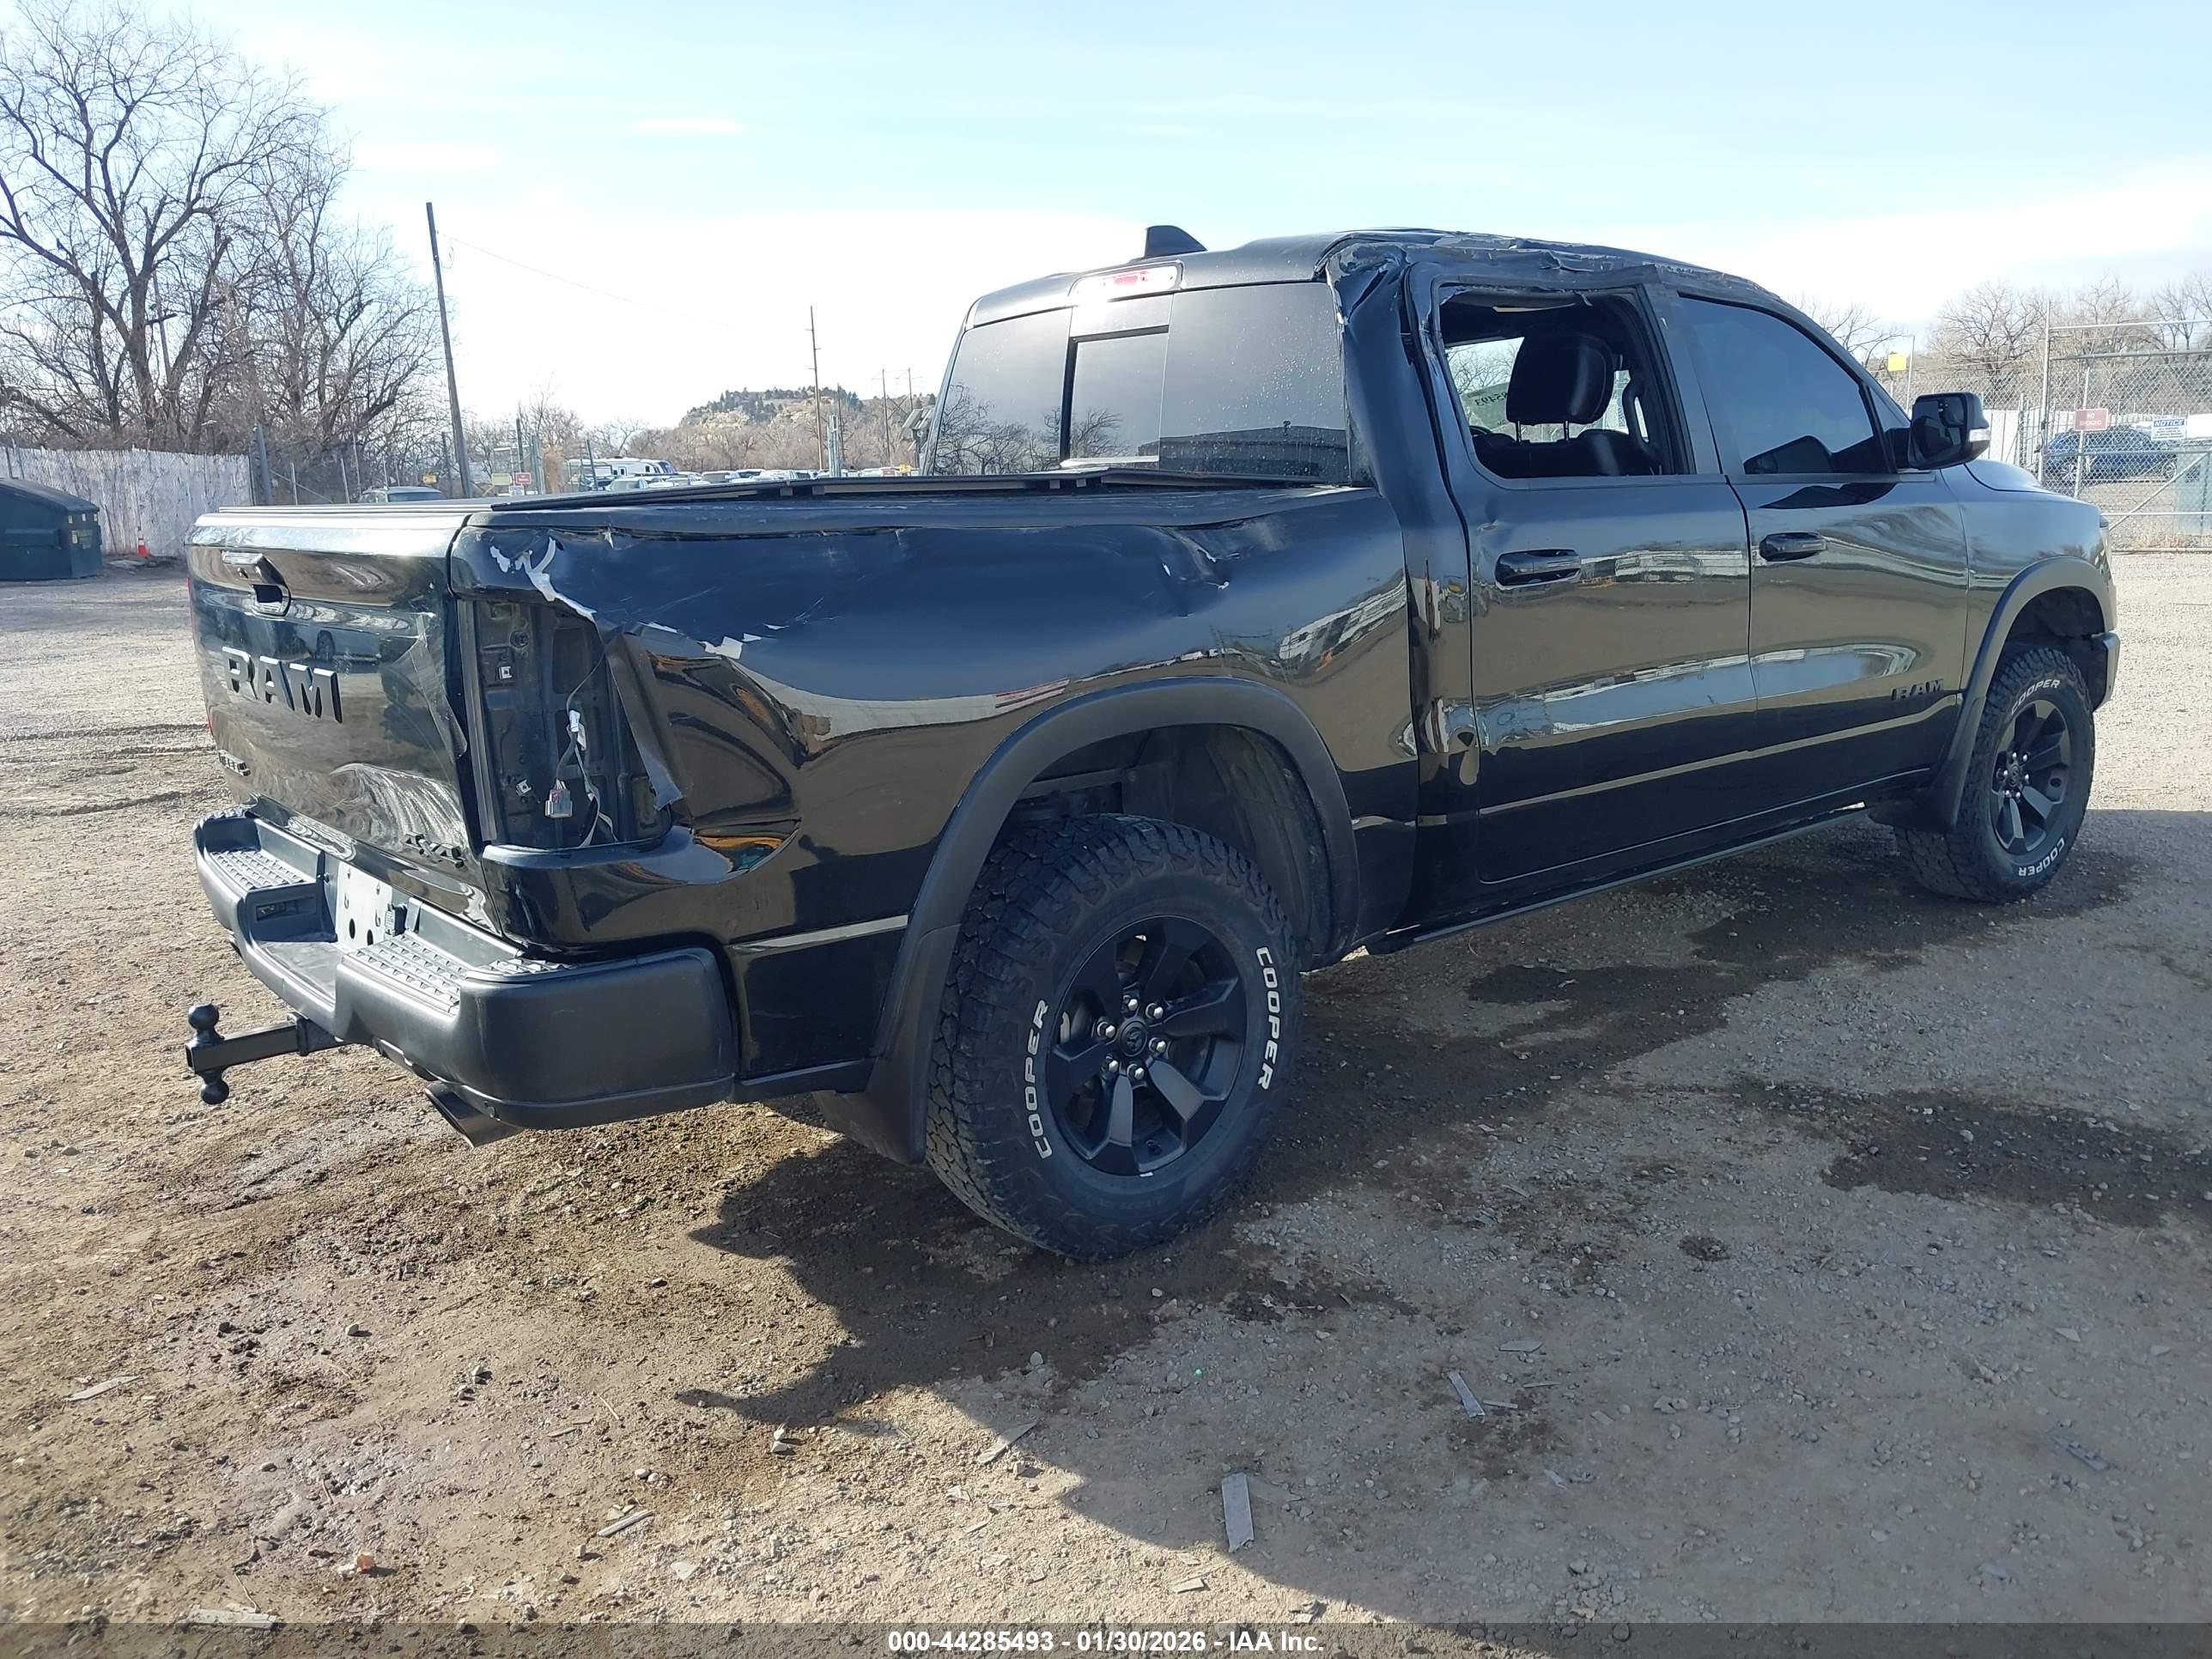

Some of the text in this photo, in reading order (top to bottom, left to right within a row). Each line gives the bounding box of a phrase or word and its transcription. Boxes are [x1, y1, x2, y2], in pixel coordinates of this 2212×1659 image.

[222, 646, 343, 723] RAM
[2011, 678, 2061, 715] COOPER
[2018, 837, 2065, 877] COOPER
[1255, 946, 1281, 1091] COOPER
[1024, 1000, 1053, 1159] COOPER
